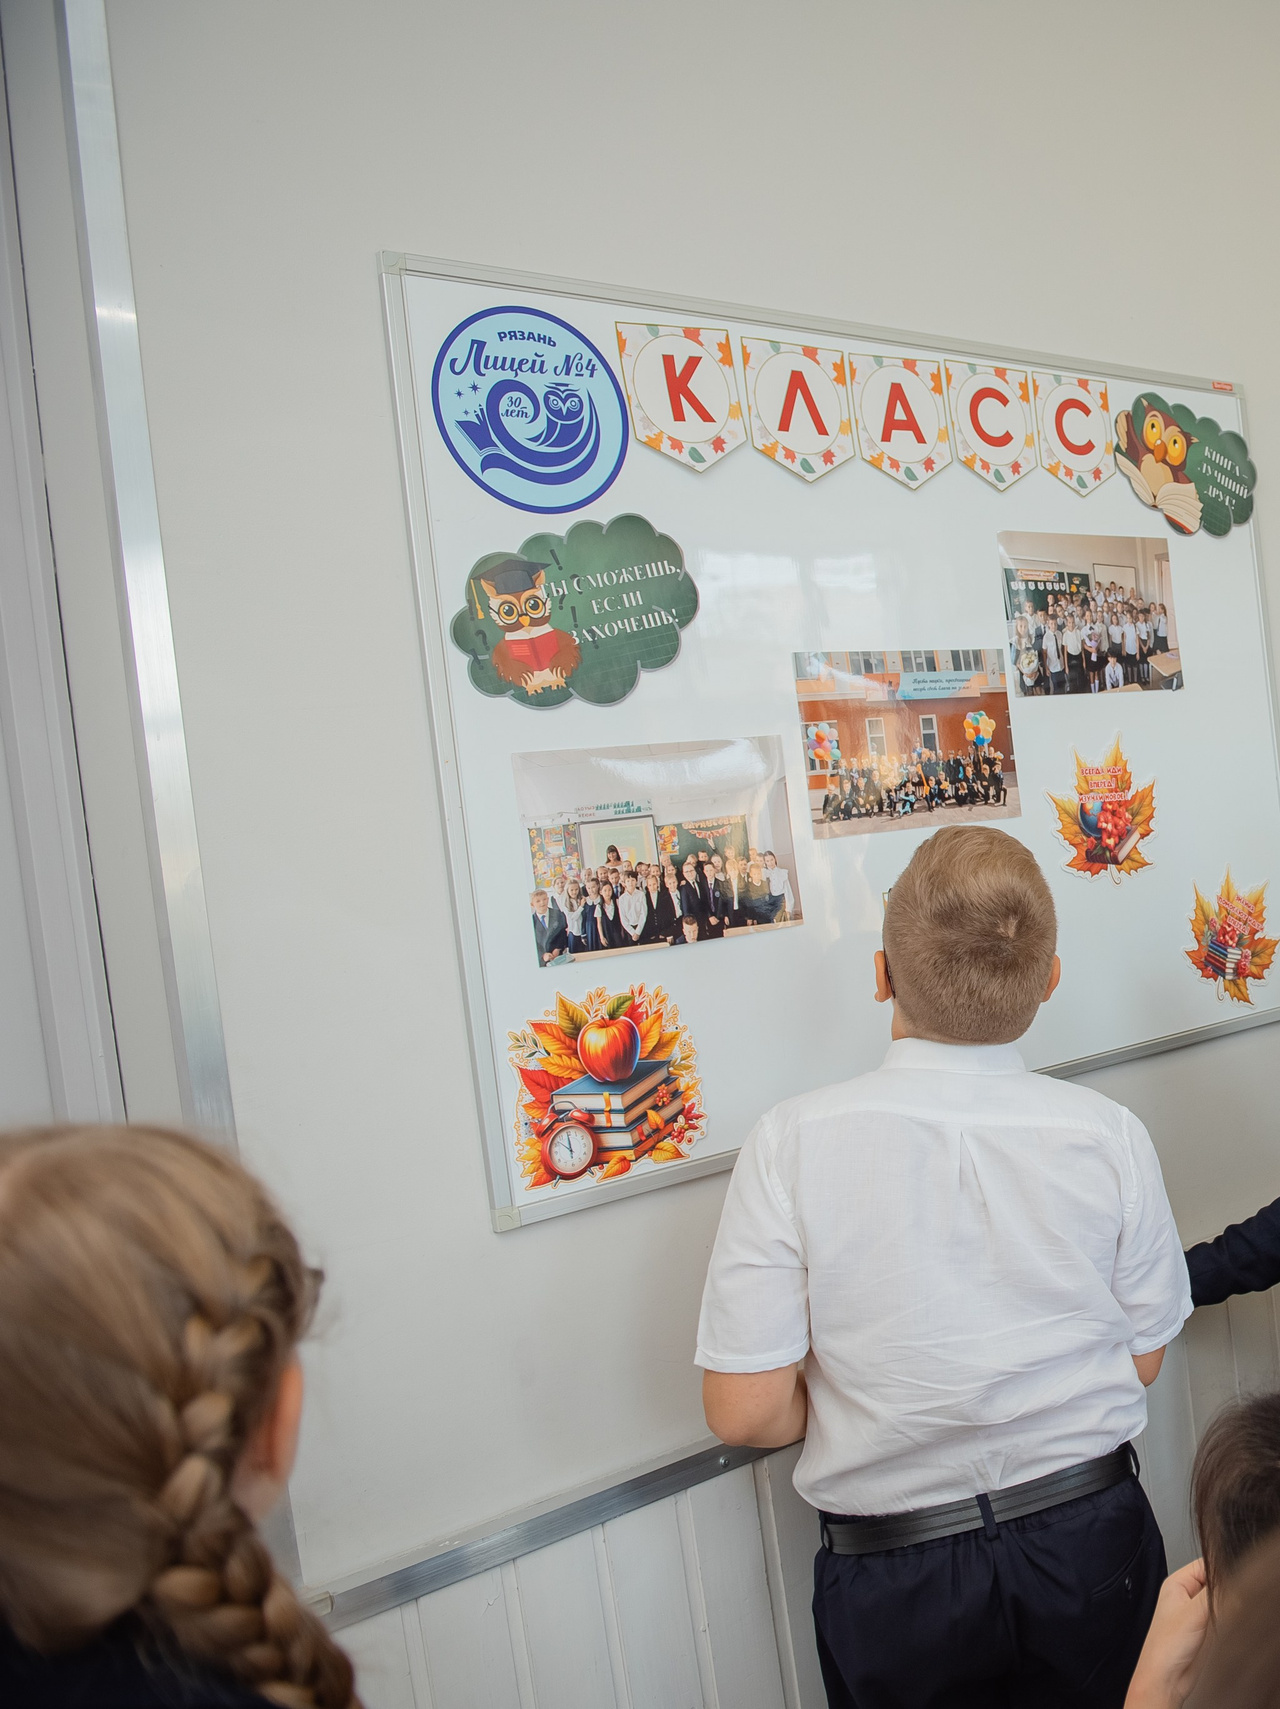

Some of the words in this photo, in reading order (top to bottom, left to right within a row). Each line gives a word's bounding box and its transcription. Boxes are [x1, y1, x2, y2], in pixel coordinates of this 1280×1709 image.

[497, 330, 557, 348] РЯЗАНЬ
[450, 339, 548, 379] Лицей
[501, 406, 531, 419] лет
[506, 396, 522, 408] 30
[661, 353, 1096, 456] КЛАСС
[1204, 445, 1240, 477] КНИГА
[1198, 462, 1248, 499] ЛУЧШИЙ
[1203, 485, 1236, 510] ДРУГ!
[536, 579, 568, 600] ТЫ
[572, 560, 681, 594] СМОЖЕШЬ,
[591, 591, 644, 615] ЕСЛИ
